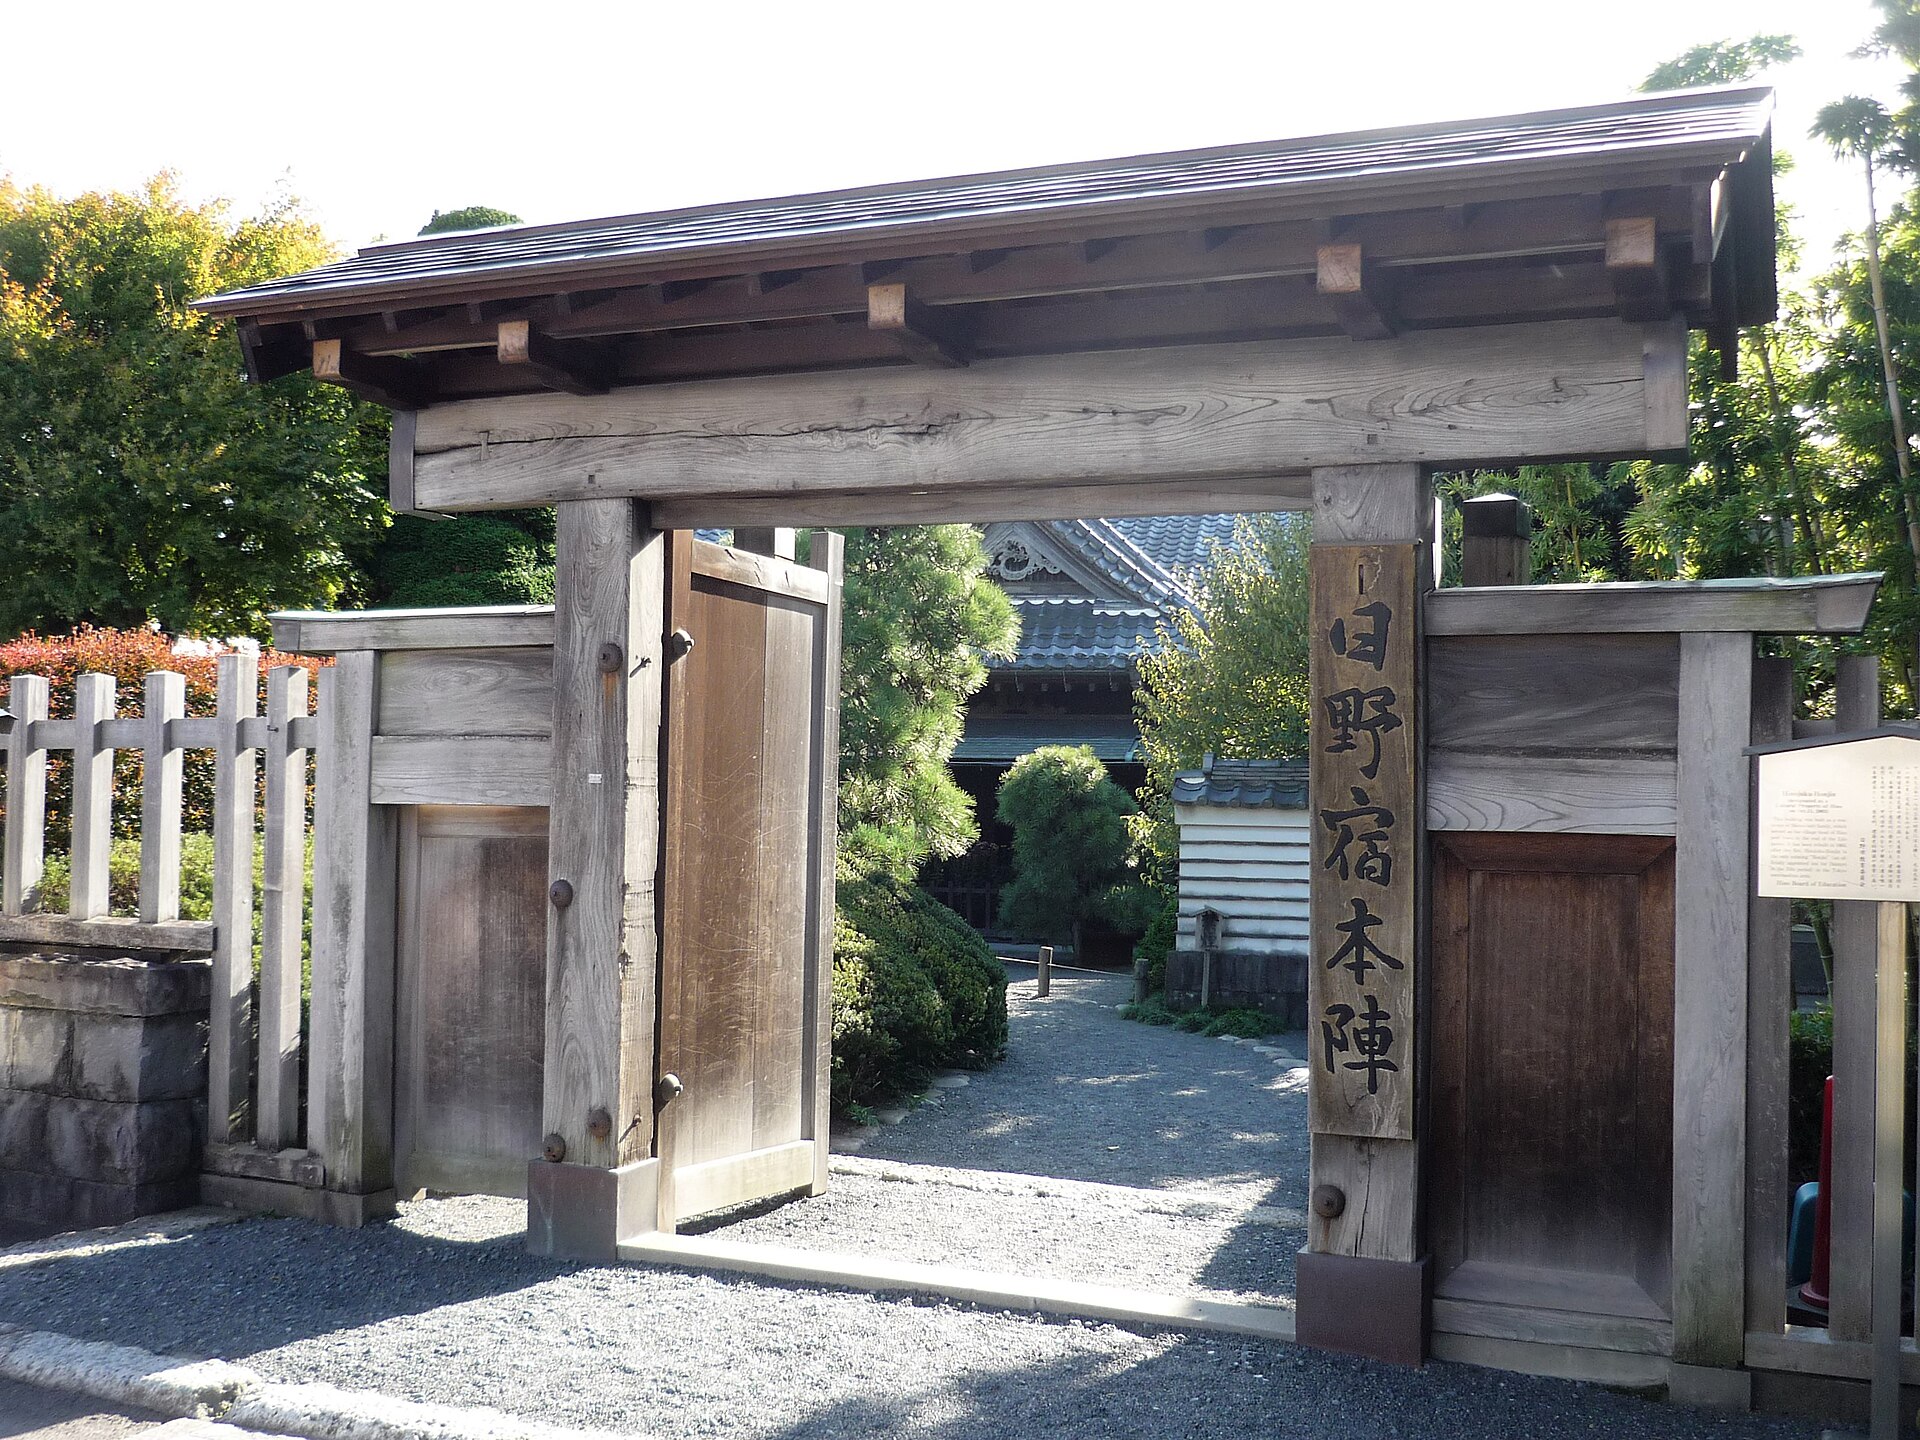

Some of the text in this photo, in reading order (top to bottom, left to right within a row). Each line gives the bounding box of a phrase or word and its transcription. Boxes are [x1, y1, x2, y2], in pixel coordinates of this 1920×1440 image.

[1320, 601, 1404, 1095] 日野宿本陣
